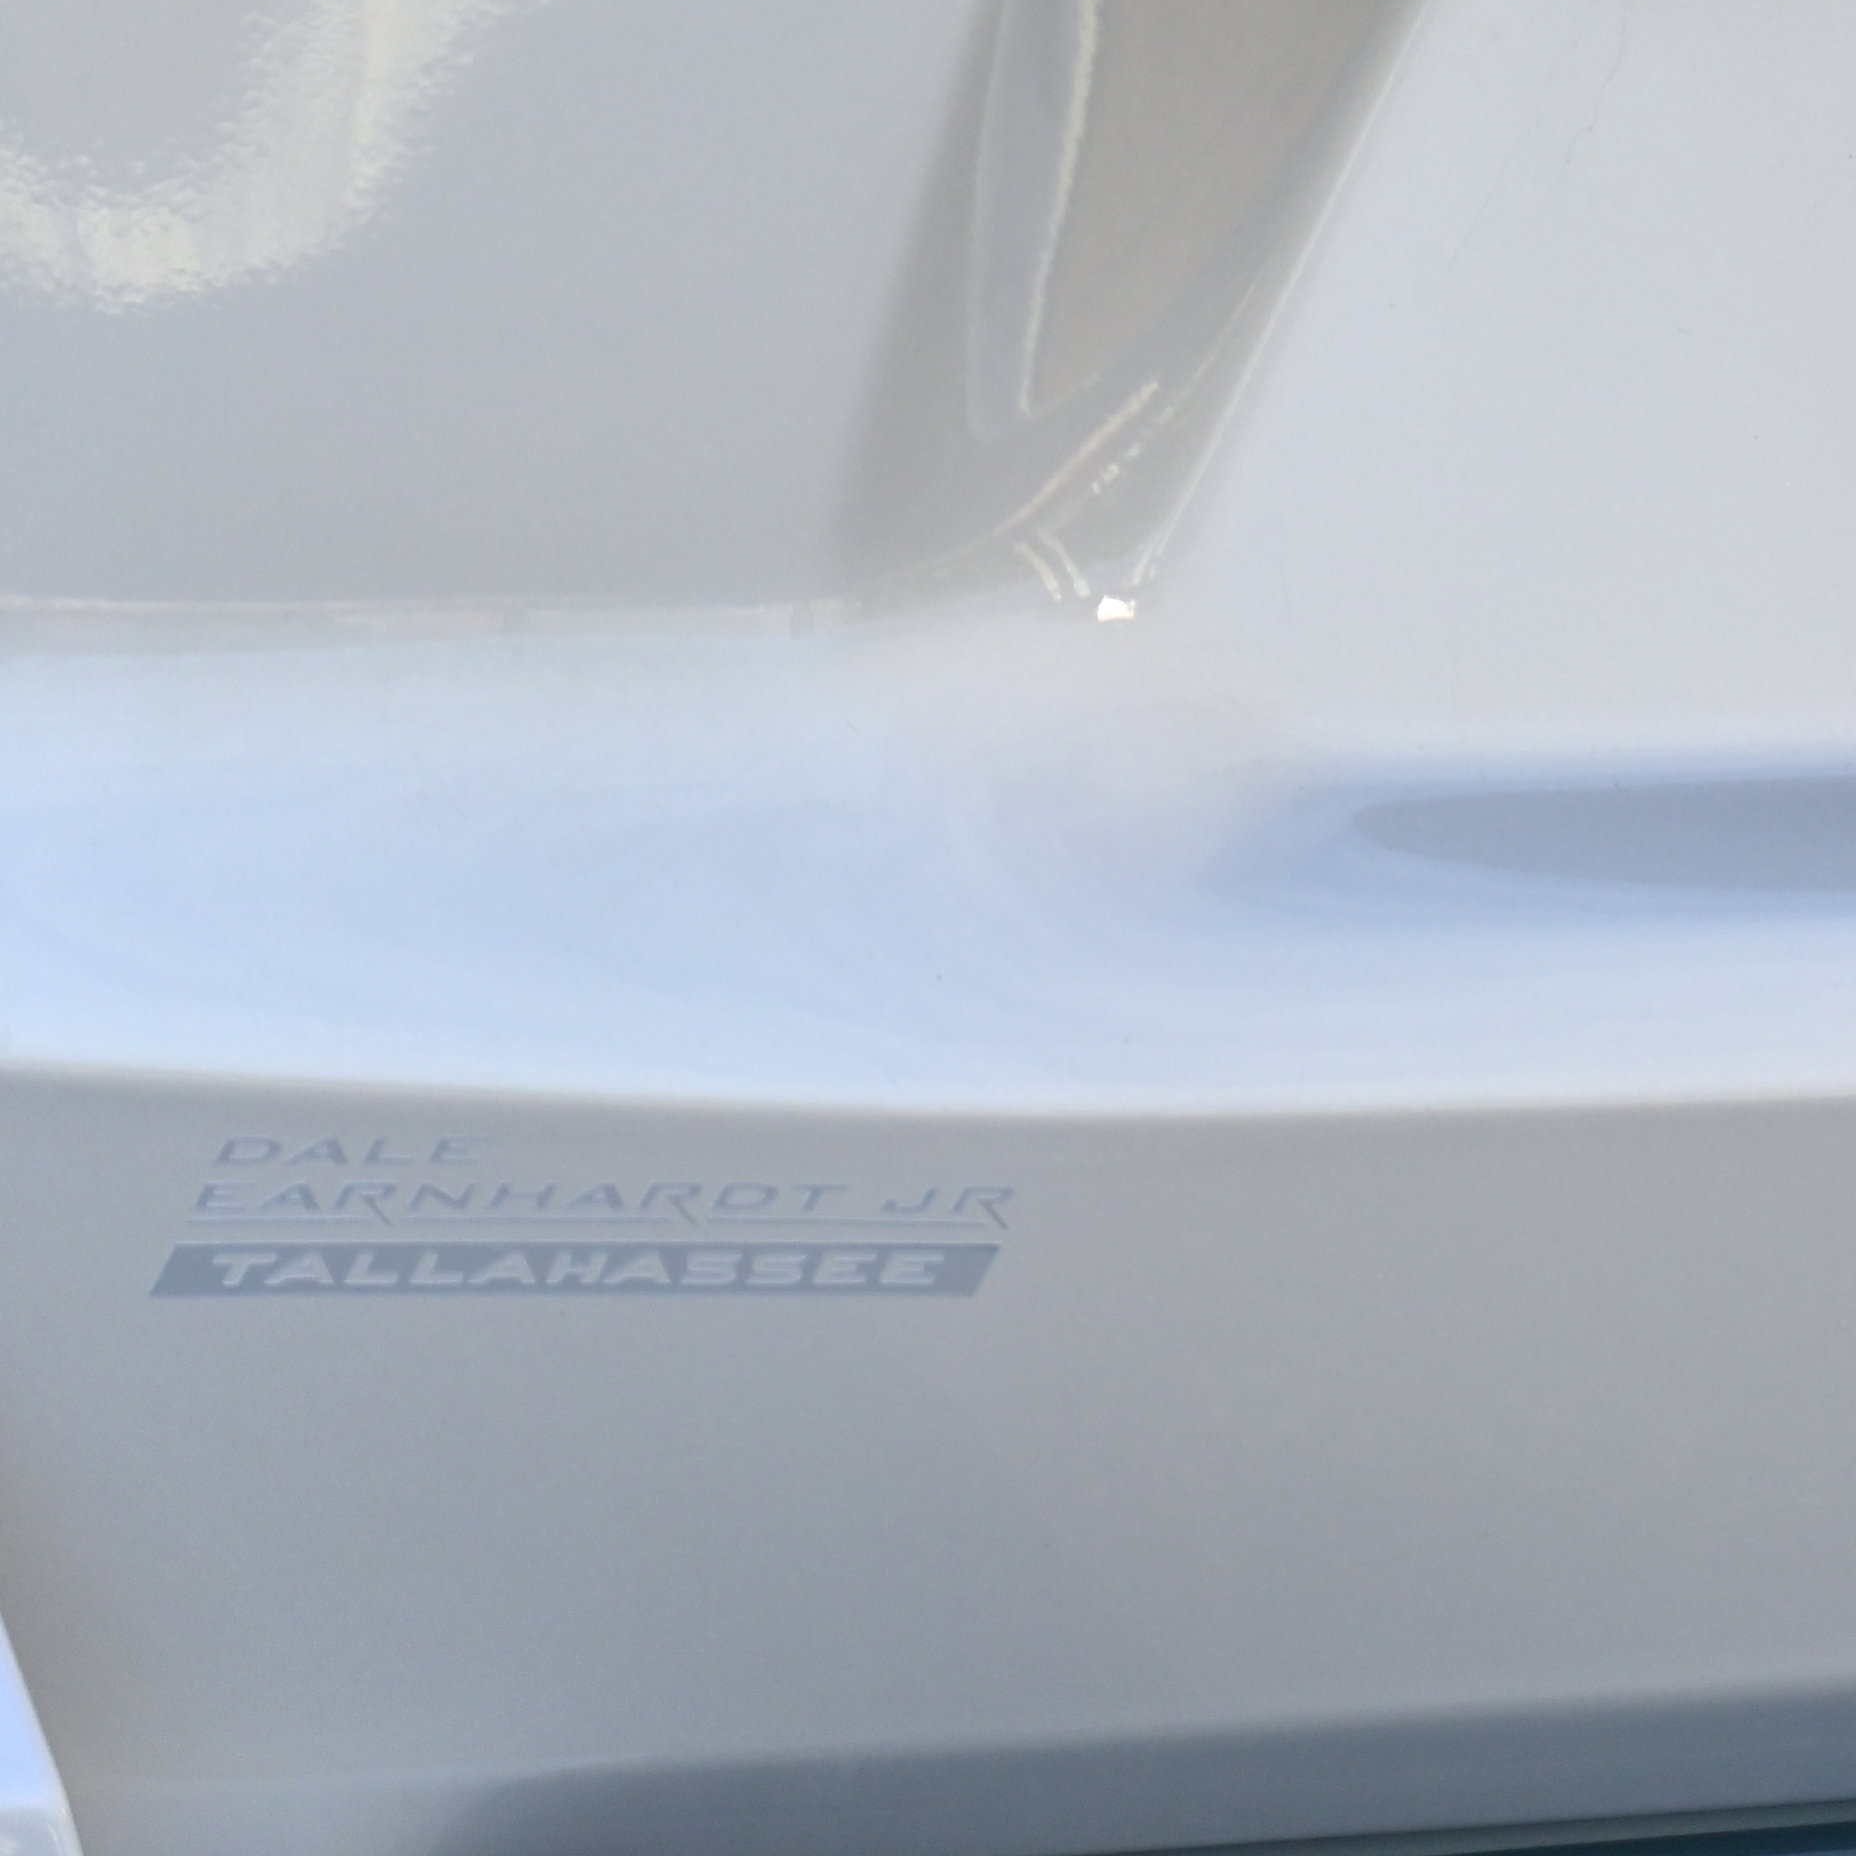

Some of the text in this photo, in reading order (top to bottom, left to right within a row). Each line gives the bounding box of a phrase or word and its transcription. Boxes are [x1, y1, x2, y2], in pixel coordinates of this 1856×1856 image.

[214, 1136, 488, 1165] DALE
[194, 1180, 1014, 1230] EARNHARDT JR
[211, 1248, 944, 1287] TALLAHASSEE
